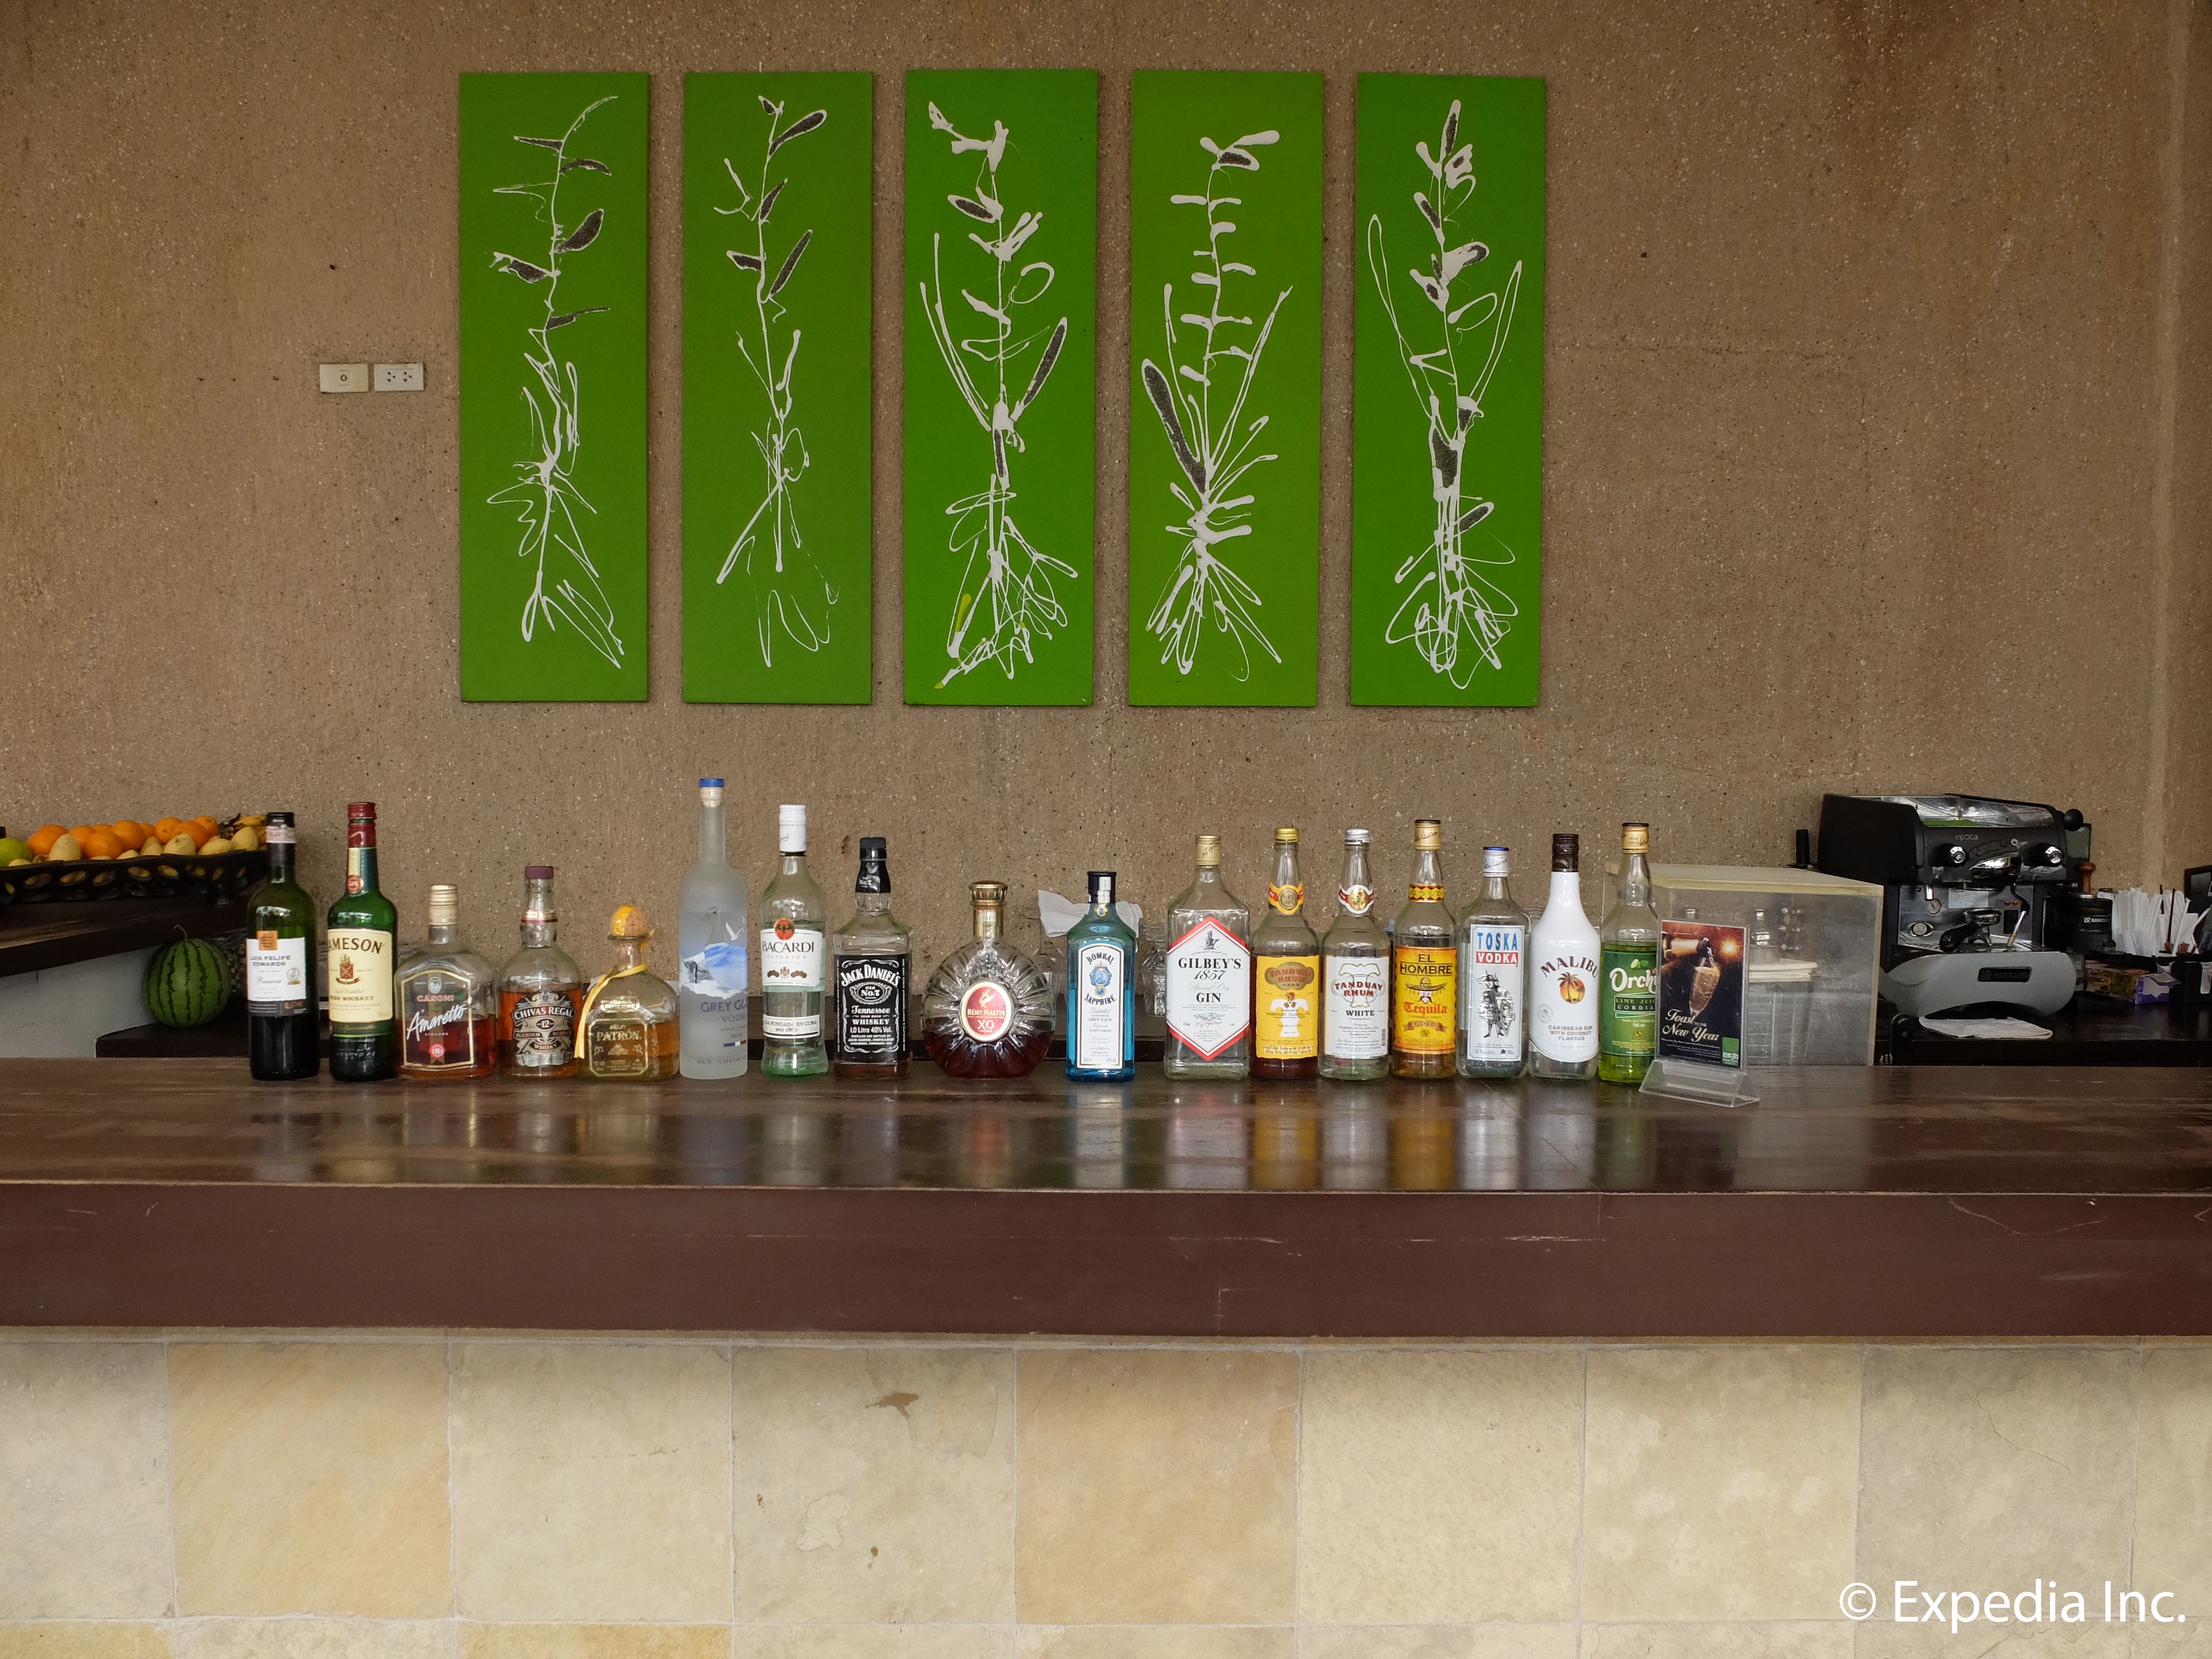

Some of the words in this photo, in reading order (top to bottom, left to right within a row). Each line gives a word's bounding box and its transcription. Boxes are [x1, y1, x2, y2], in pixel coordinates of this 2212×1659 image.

[762, 941, 814, 953] BACARDI
[1478, 933, 1517, 950] TOSKA
[1086, 952, 1115, 965] BOMBAY
[1178, 957, 1242, 969] GILBEY'S
[1419, 954, 1435, 963] EL
[1478, 953, 1517, 963] VODKA
[1400, 963, 1452, 974] HOMBRE
[1540, 956, 1599, 978] MALIBU
[840, 968, 864, 987] JACK
[864, 964, 901, 987] DANIEL'S
[1194, 969, 1226, 980] 1857
[1335, 982, 1382, 990] TANDUAY
[1084, 993, 1116, 1005] SAPPHIRE
[1196, 993, 1221, 1003] GIN
[701, 1001, 732, 1012] GREY
[851, 1005, 891, 1014] Tennessee
[1404, 1002, 1448, 1015] Tequila
[514, 1007, 546, 1020] CHIVAS
[548, 1007, 573, 1017] REGAL
[1665, 1009, 1696, 1024] Toast
[407, 1004, 467, 1041] Amaretto
[541, 1020, 550, 1028] 12
[977, 1020, 995, 1030] XO
[1662, 1023, 1689, 1036] New
[1691, 1027, 1719, 1042] Year
